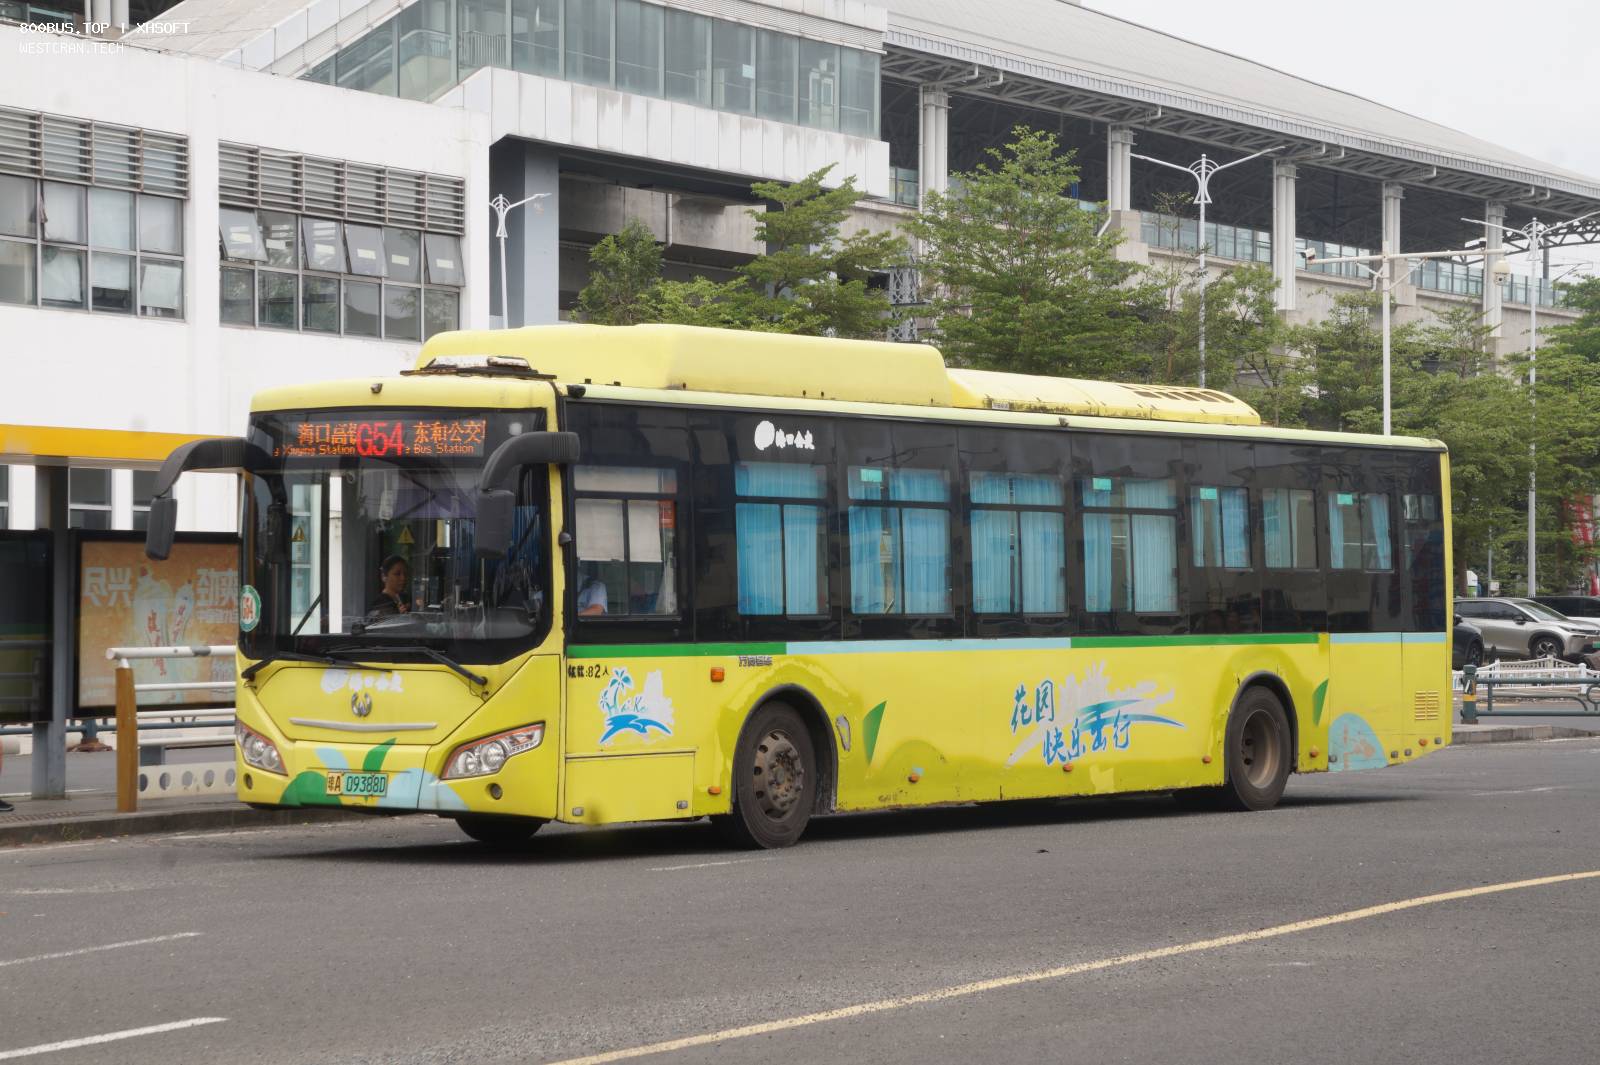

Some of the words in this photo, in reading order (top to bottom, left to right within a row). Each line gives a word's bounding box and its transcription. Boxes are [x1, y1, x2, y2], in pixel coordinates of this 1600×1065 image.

[357, 421, 405, 456] G54
[320, 443, 355, 453] Station
[414, 444, 432, 454] Bus
[438, 443, 474, 454] Station
